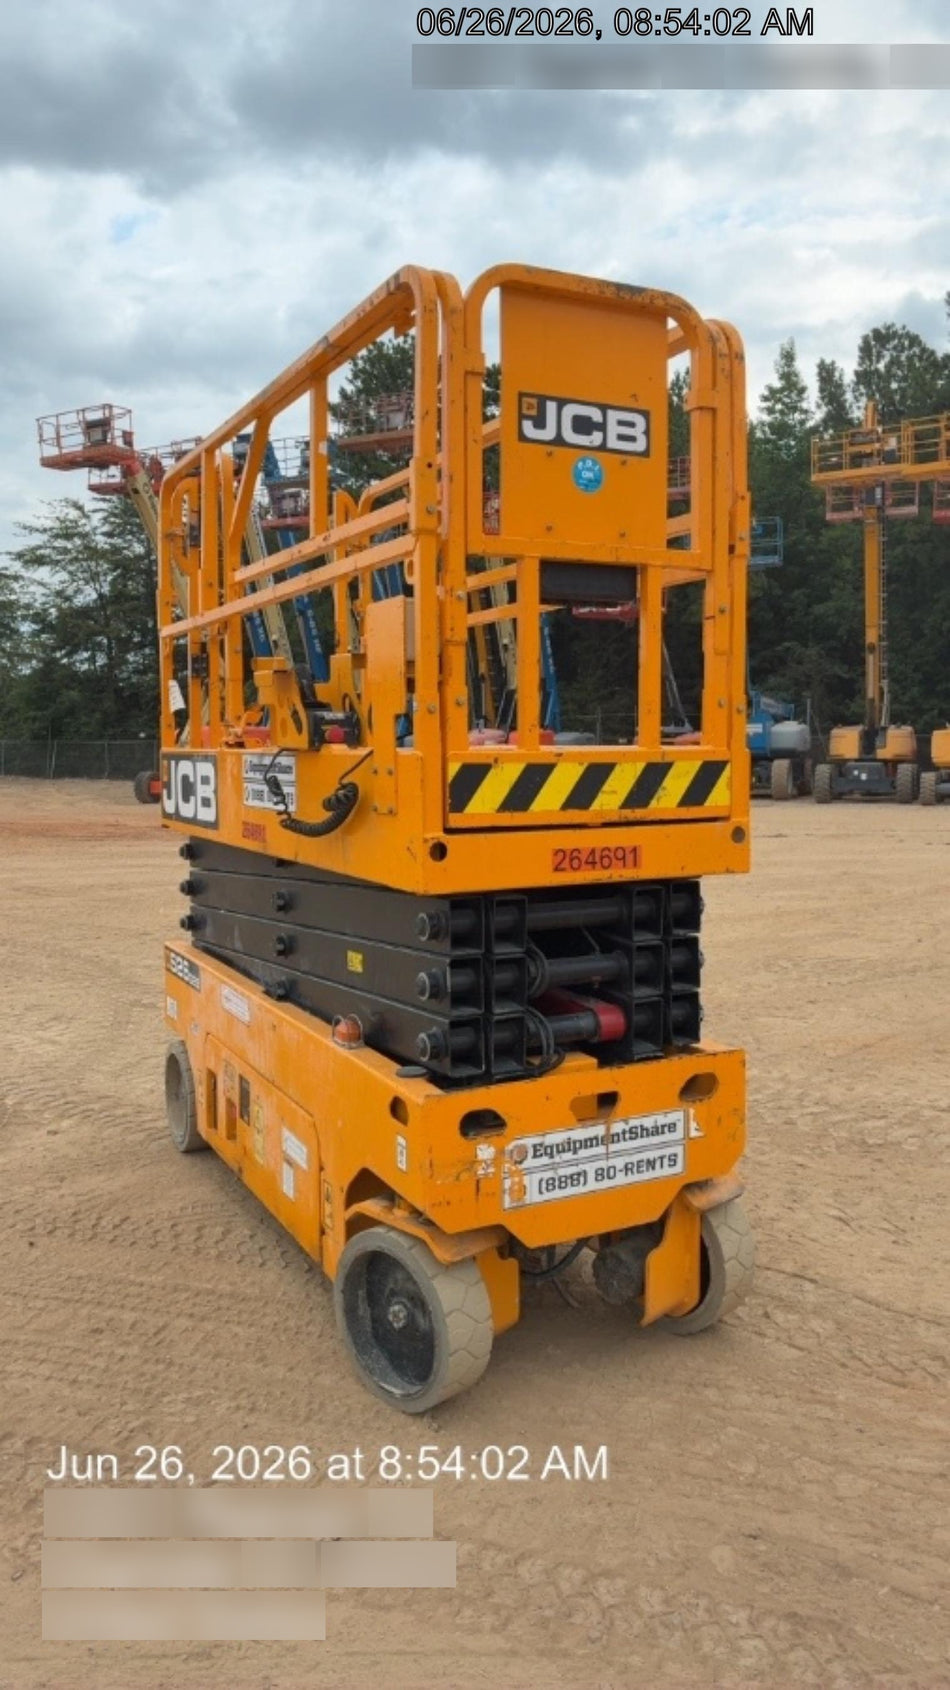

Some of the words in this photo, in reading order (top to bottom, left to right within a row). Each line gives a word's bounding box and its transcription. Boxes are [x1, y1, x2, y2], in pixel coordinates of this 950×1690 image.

[521, 399, 648, 452] JCB
[162, 759, 216, 823] JCB
[552, 846, 638, 872] 264691
[531, 1120, 678, 1161] EquipmentShare
[538, 1170, 588, 1195] (888)
[594, 1152, 679, 1183] 80-RENTS
